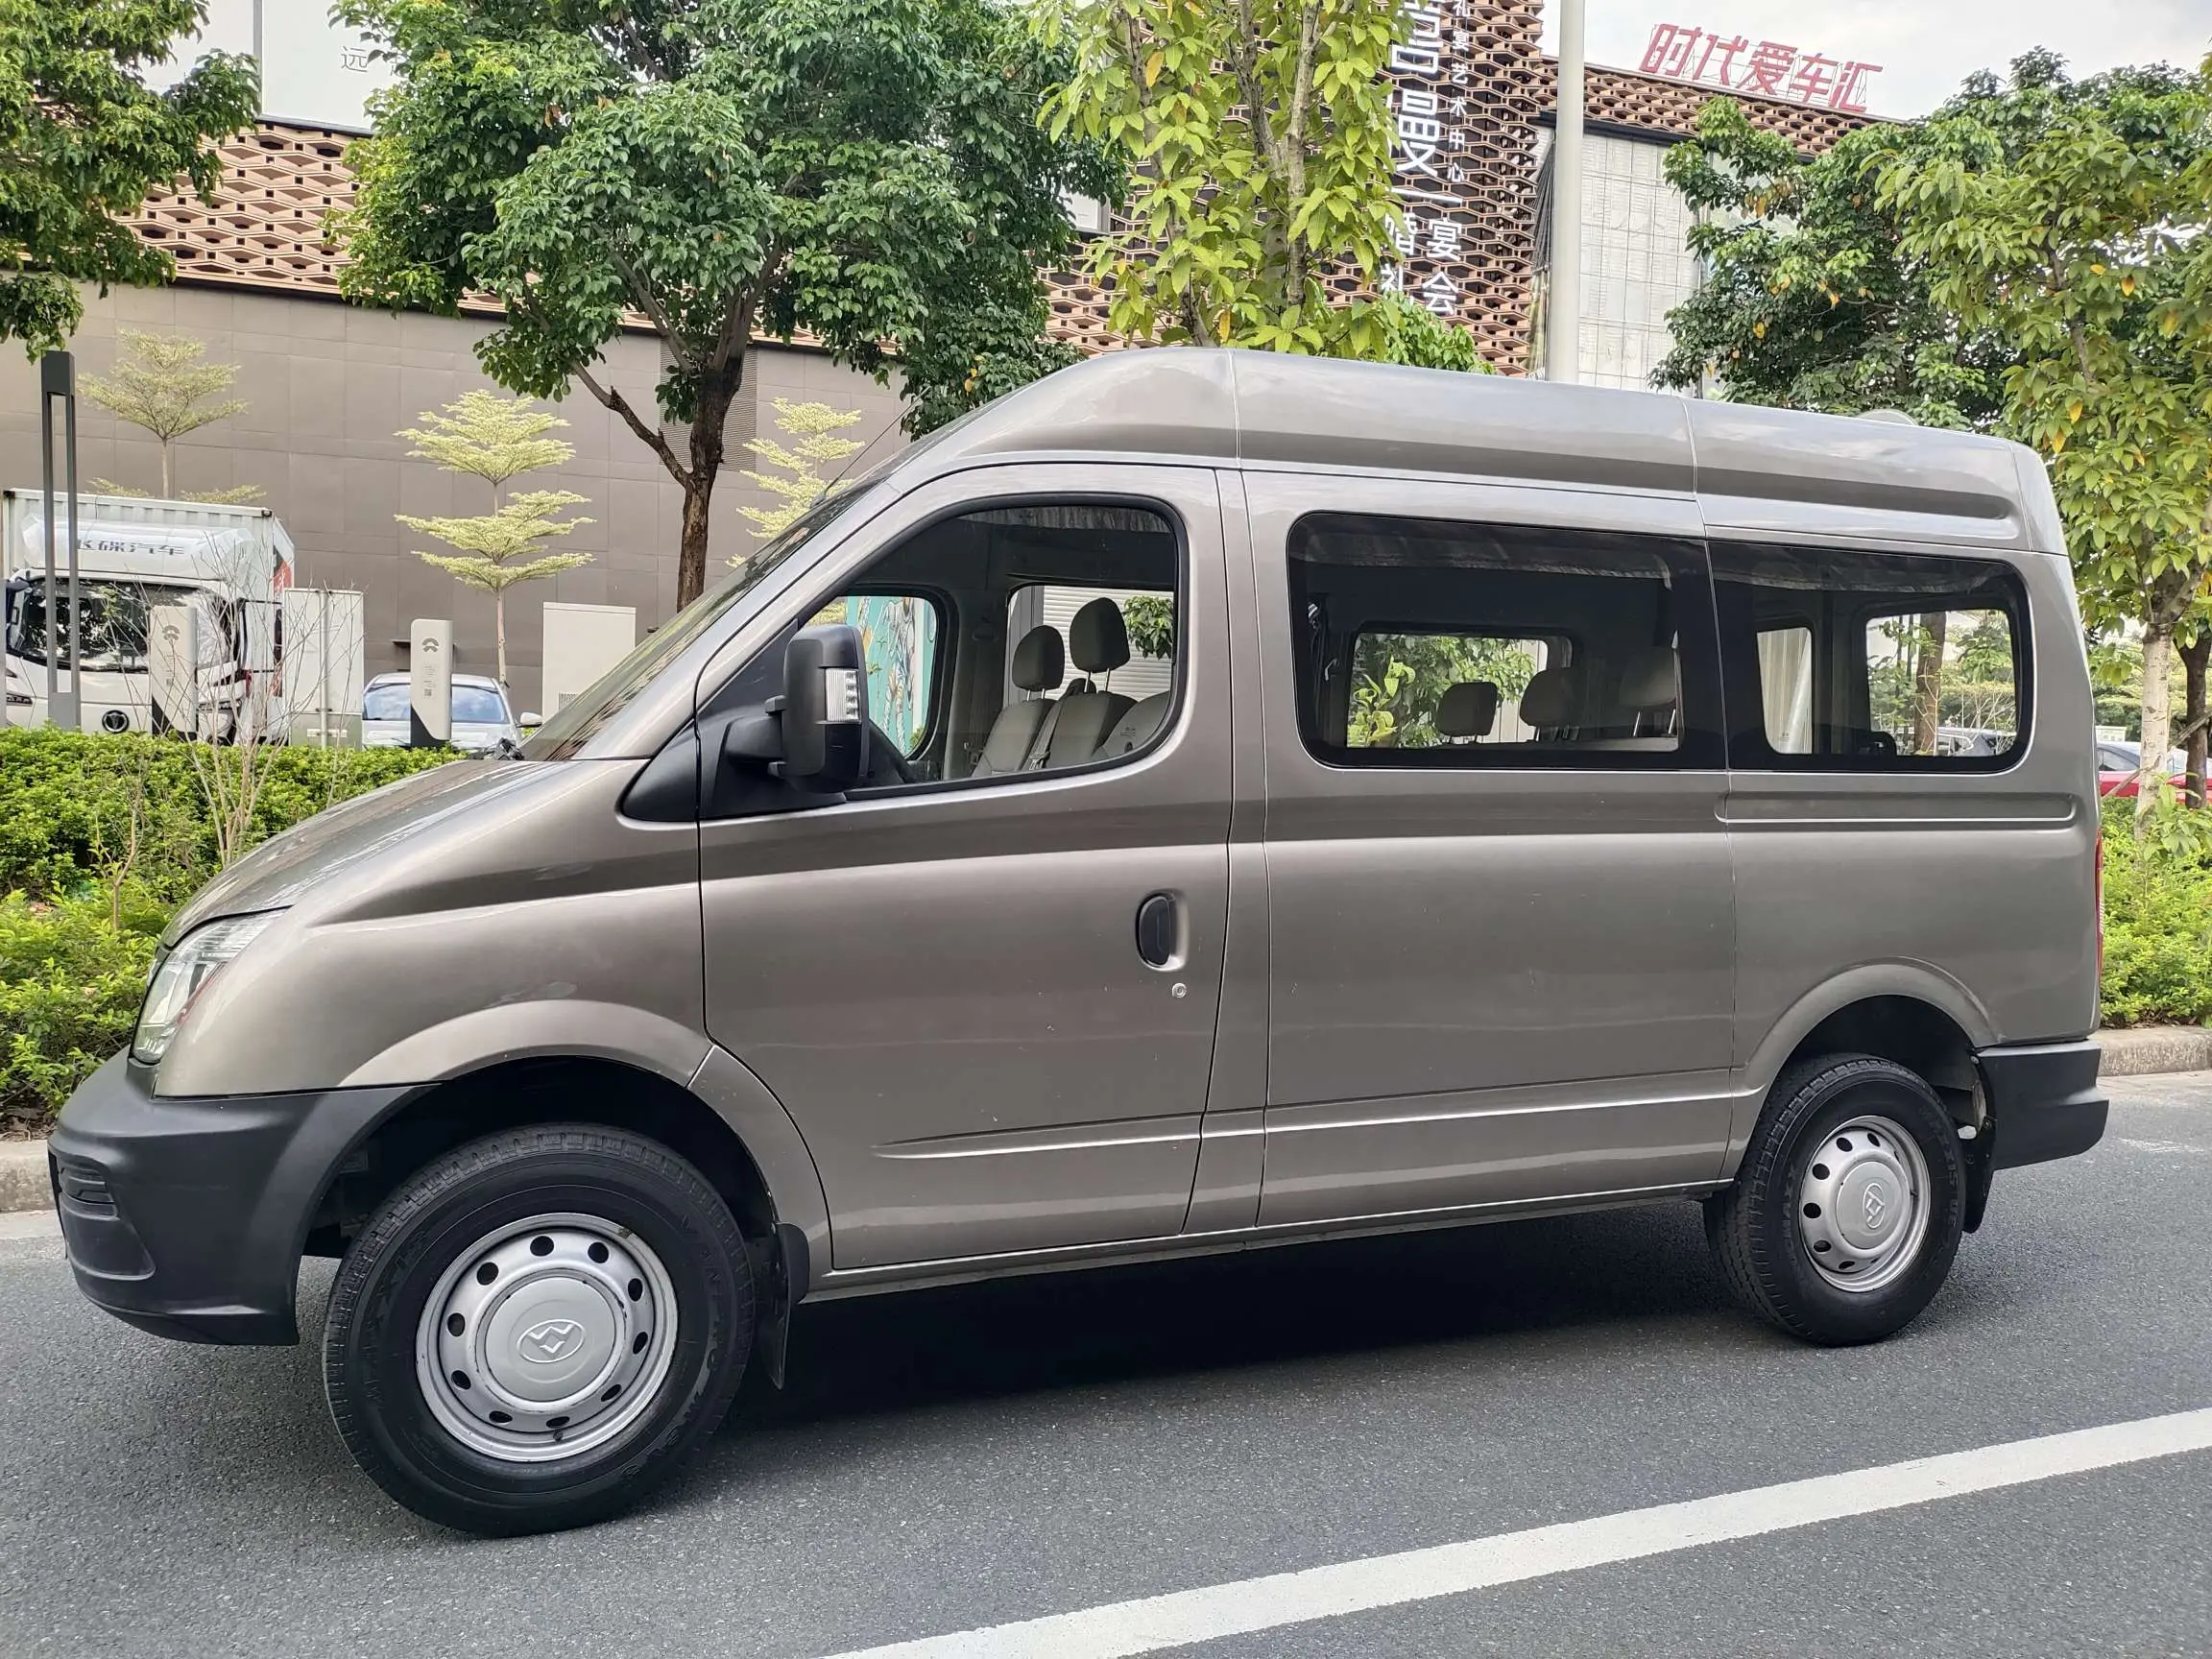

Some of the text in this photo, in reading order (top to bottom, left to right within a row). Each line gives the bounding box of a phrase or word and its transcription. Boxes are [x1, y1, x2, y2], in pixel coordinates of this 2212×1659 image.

[1639, 24, 1883, 113] 时代爱车汇
